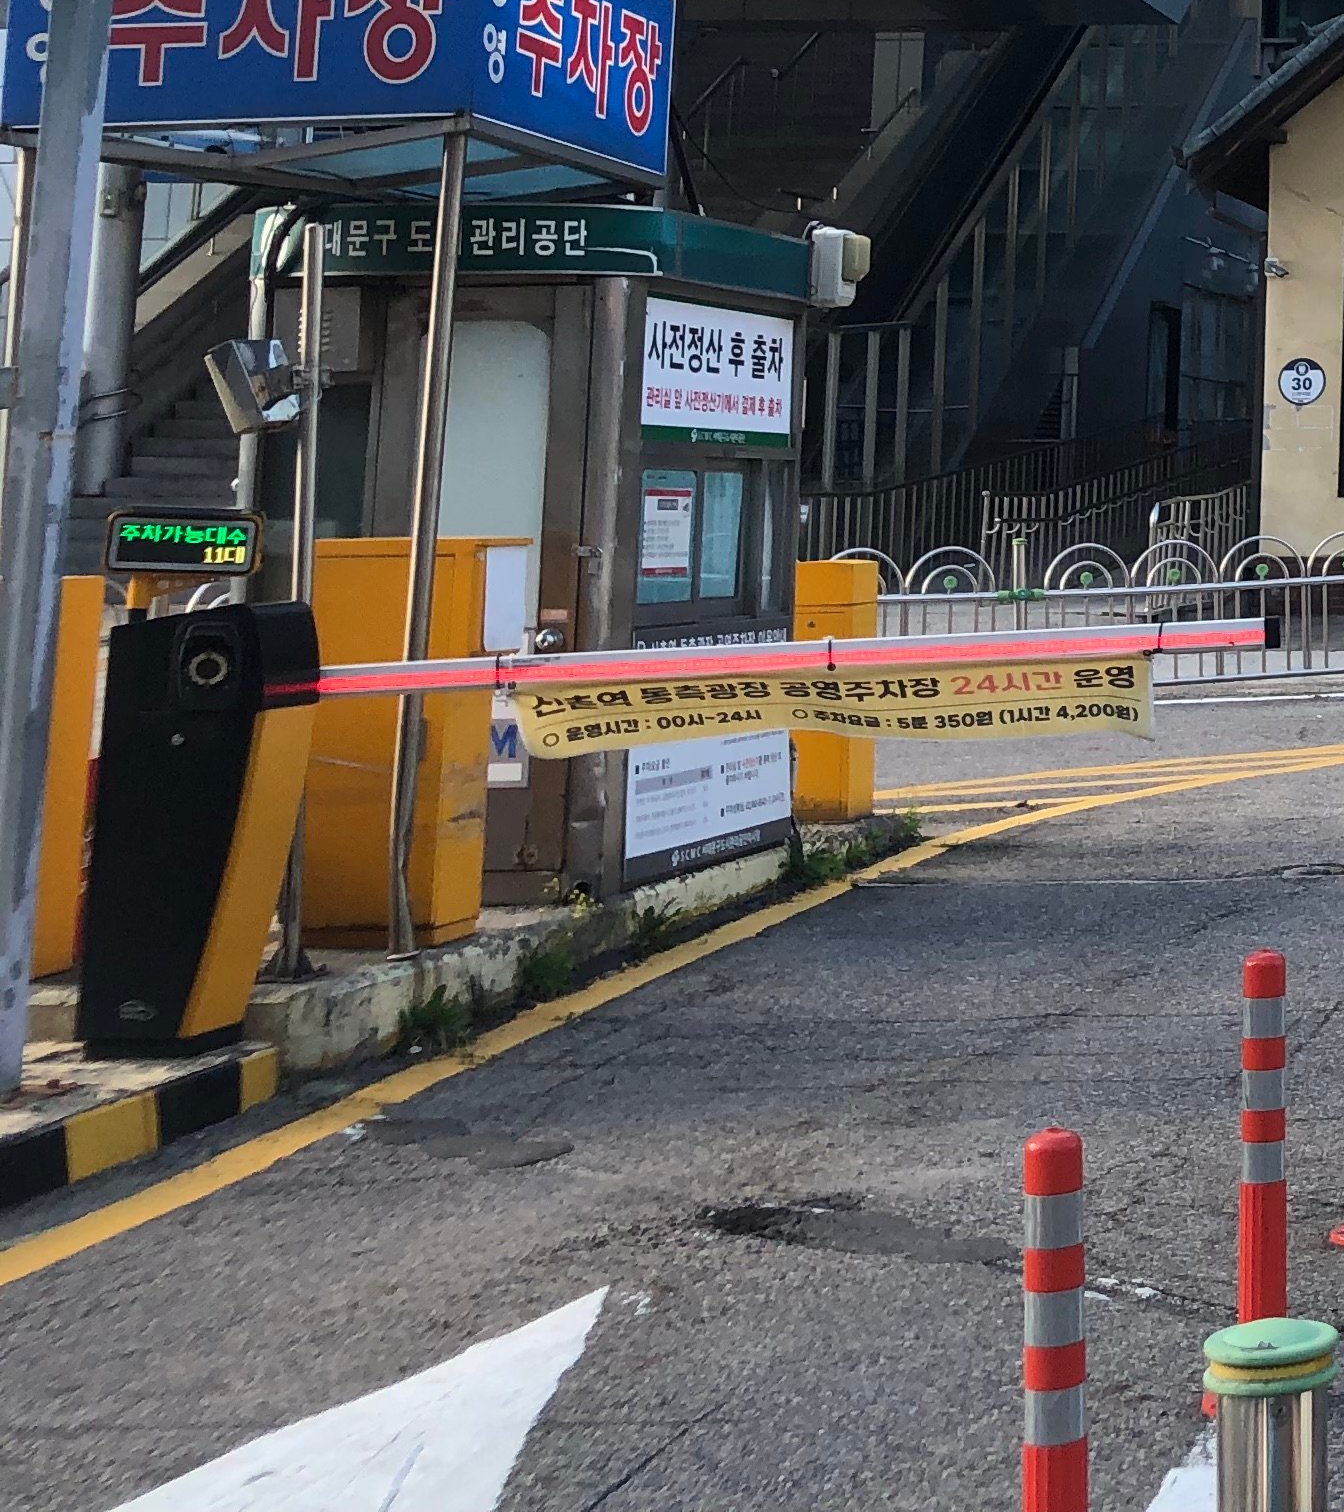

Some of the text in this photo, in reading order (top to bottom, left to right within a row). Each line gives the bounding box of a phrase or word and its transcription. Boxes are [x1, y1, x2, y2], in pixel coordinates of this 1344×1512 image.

[304, 218, 588, 257] 대문구 도관리공단
[648, 321, 784, 382] 사전정산 후 출차
[1291, 377, 1313, 391] 30
[119, 523, 247, 545] 주차가능대수
[203, 545, 246, 564] 11대
[532, 689, 633, 718] 신촌역
[780, 677, 941, 703] 공영주차장
[950, 669, 1064, 697] 24시간
[1072, 665, 1135, 690] 운영
[565, 718, 640, 743] 운영시간
[813, 709, 881, 728] 주차요금
[896, 715, 929, 730] 5분
[934, 711, 994, 730] 350원
[999, 705, 1051, 726] (1시간
[1056, 702, 1140, 723] 4,200원)
